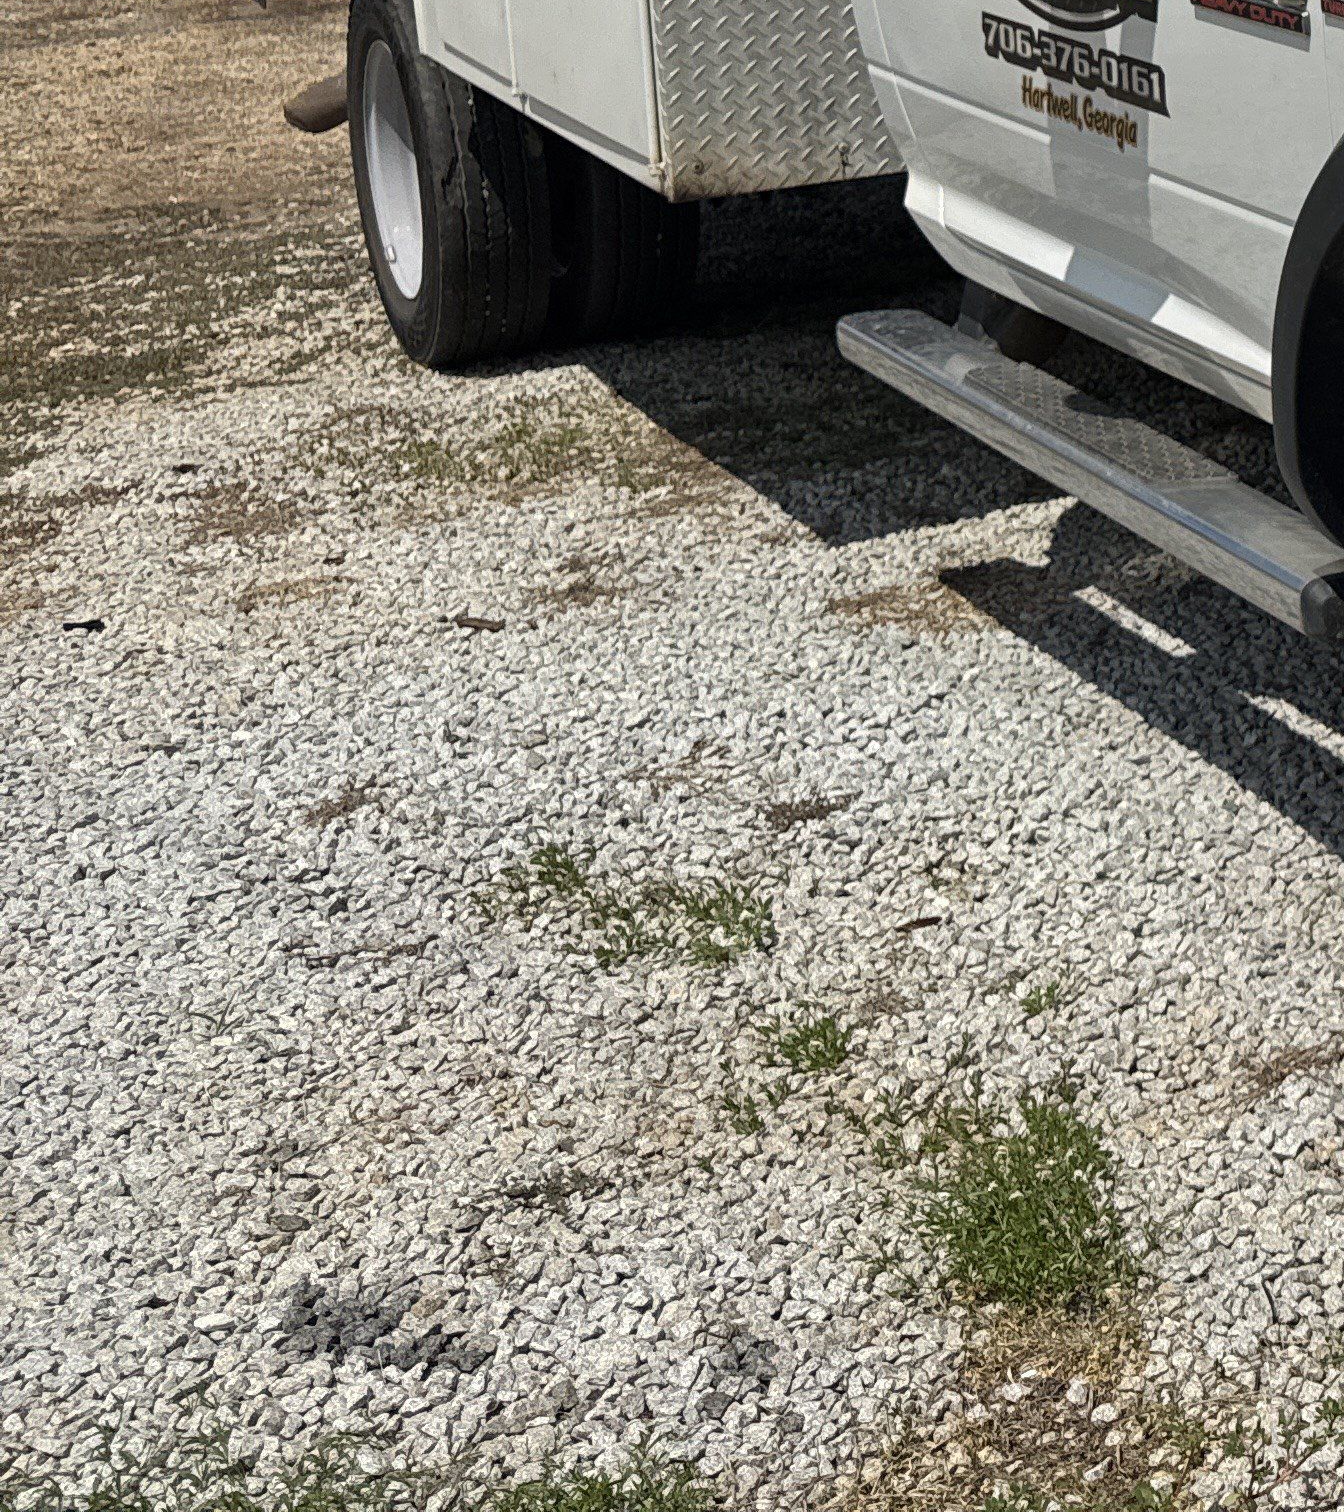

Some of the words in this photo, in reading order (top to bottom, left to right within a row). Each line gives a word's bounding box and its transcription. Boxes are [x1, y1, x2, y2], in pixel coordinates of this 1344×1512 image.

[1250, 5, 1299, 30] DUTY
[985, 17, 1163, 105] 706-376-0161
[1021, 74, 1083, 132] Hartwell,
[1083, 101, 1138, 152] Georgia
